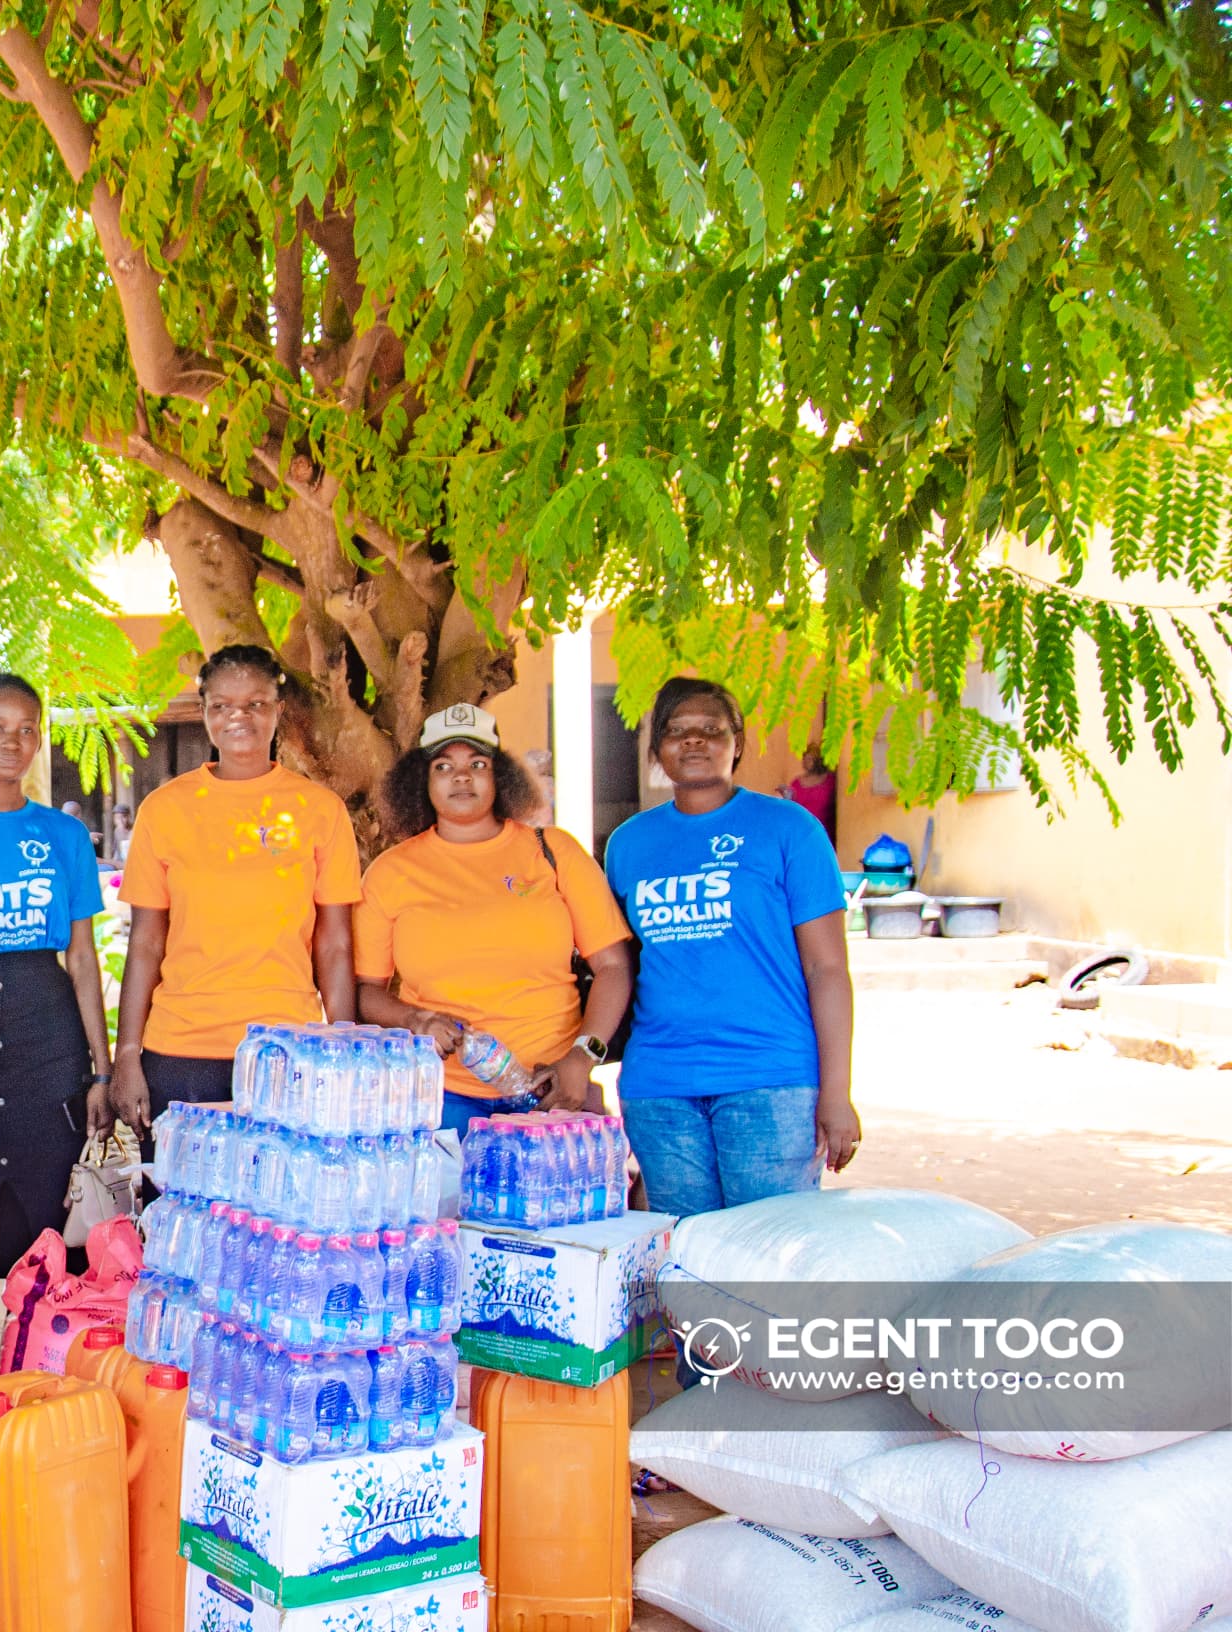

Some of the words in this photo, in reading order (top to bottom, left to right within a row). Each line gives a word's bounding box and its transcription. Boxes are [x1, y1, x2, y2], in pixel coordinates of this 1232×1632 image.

[635, 869, 731, 907] KITS
[637, 900, 732, 929] ZOKLIN
[210, 1486, 254, 1521] Vitale
[361, 1484, 439, 1525] Vitale
[753, 1524, 817, 1564] Consommation
[421, 1570, 432, 1581] 24
[820, 1545, 867, 1586] 21-86-71
[934, 1607, 965, 1625] Limite
[965, 1619, 980, 1631] de
[950, 1595, 1004, 1619] 22-14-88
